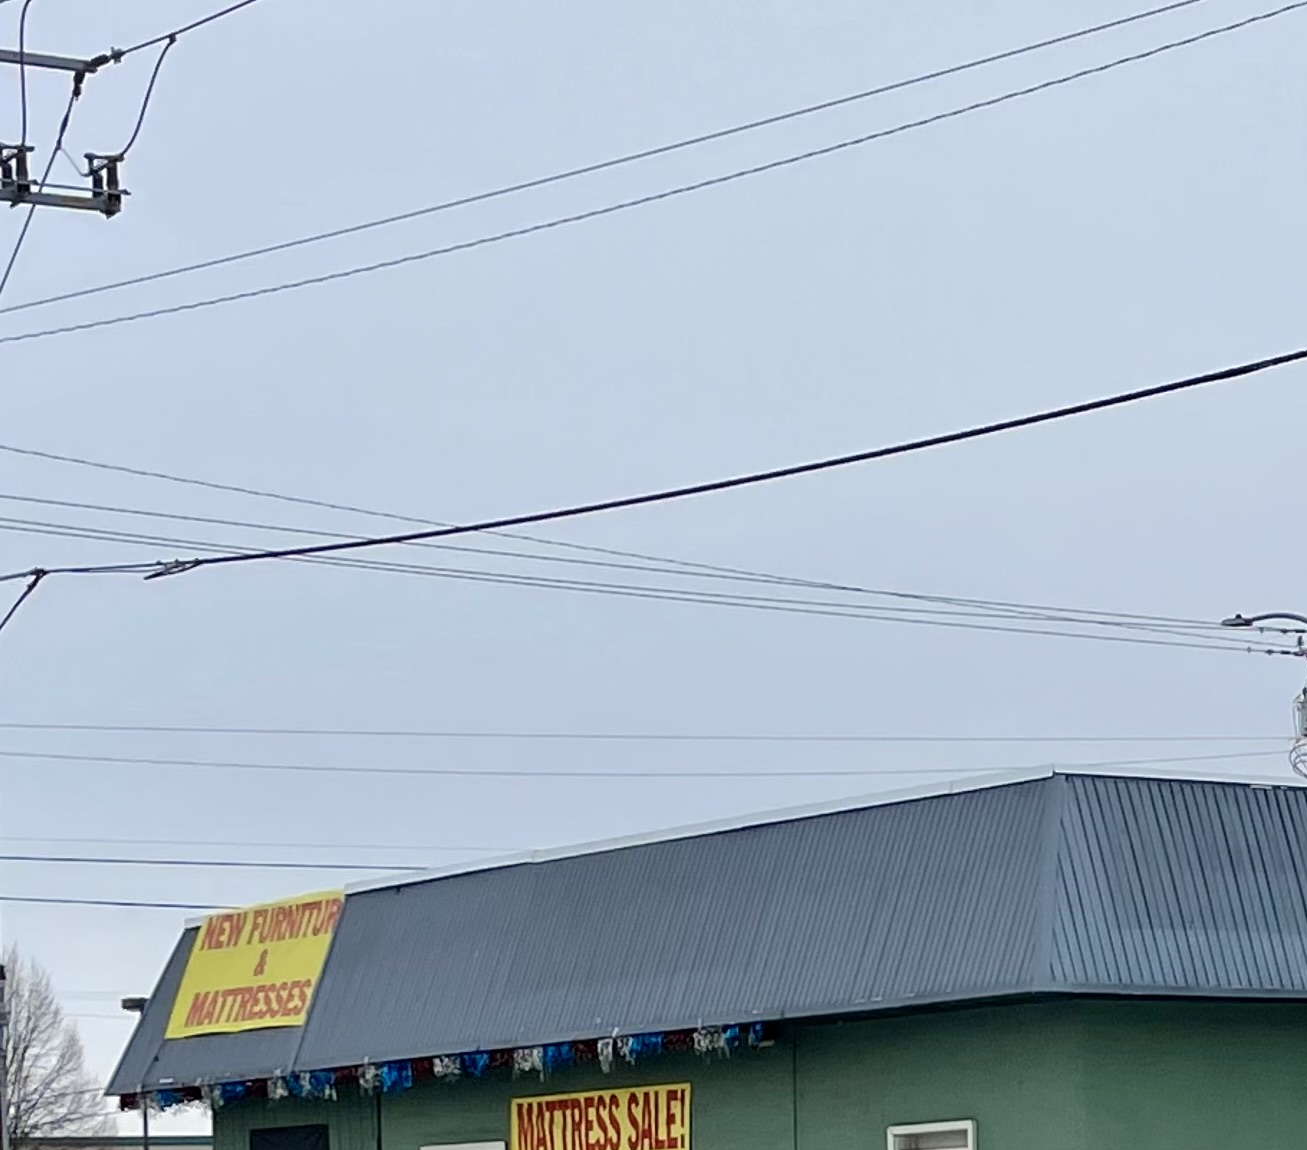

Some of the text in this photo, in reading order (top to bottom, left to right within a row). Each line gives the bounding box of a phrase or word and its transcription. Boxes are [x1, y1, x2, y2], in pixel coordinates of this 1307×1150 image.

[201, 912, 247, 950] NEW
[253, 949, 268, 976] &
[184, 979, 311, 1028] MATTRESSES
